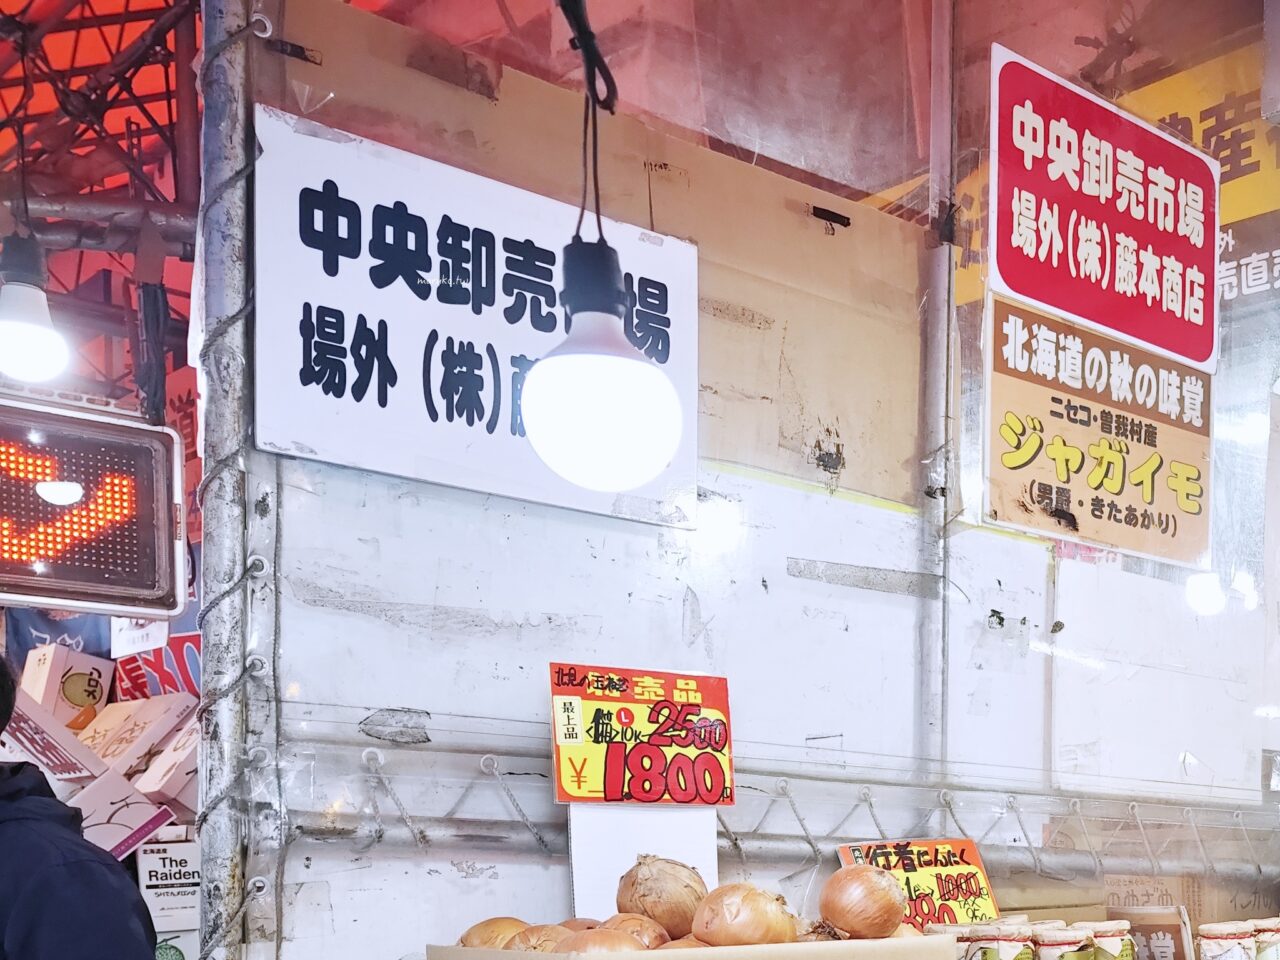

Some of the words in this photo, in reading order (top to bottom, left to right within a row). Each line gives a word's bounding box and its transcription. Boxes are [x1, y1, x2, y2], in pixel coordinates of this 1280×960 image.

[1012, 99, 1206, 249] 中央卸売市場
[299, 178, 671, 365] 中央卸売場
[1011, 187, 1205, 326] 場外(株)藤本商店
[1001, 314, 1205, 428] 北海道の秋の味覚
[998, 409, 1205, 517] ジャガイモ
[562, 701, 578, 740] 最上品
[148, 868, 200, 882] Raiden
[158, 856, 188, 869] The
